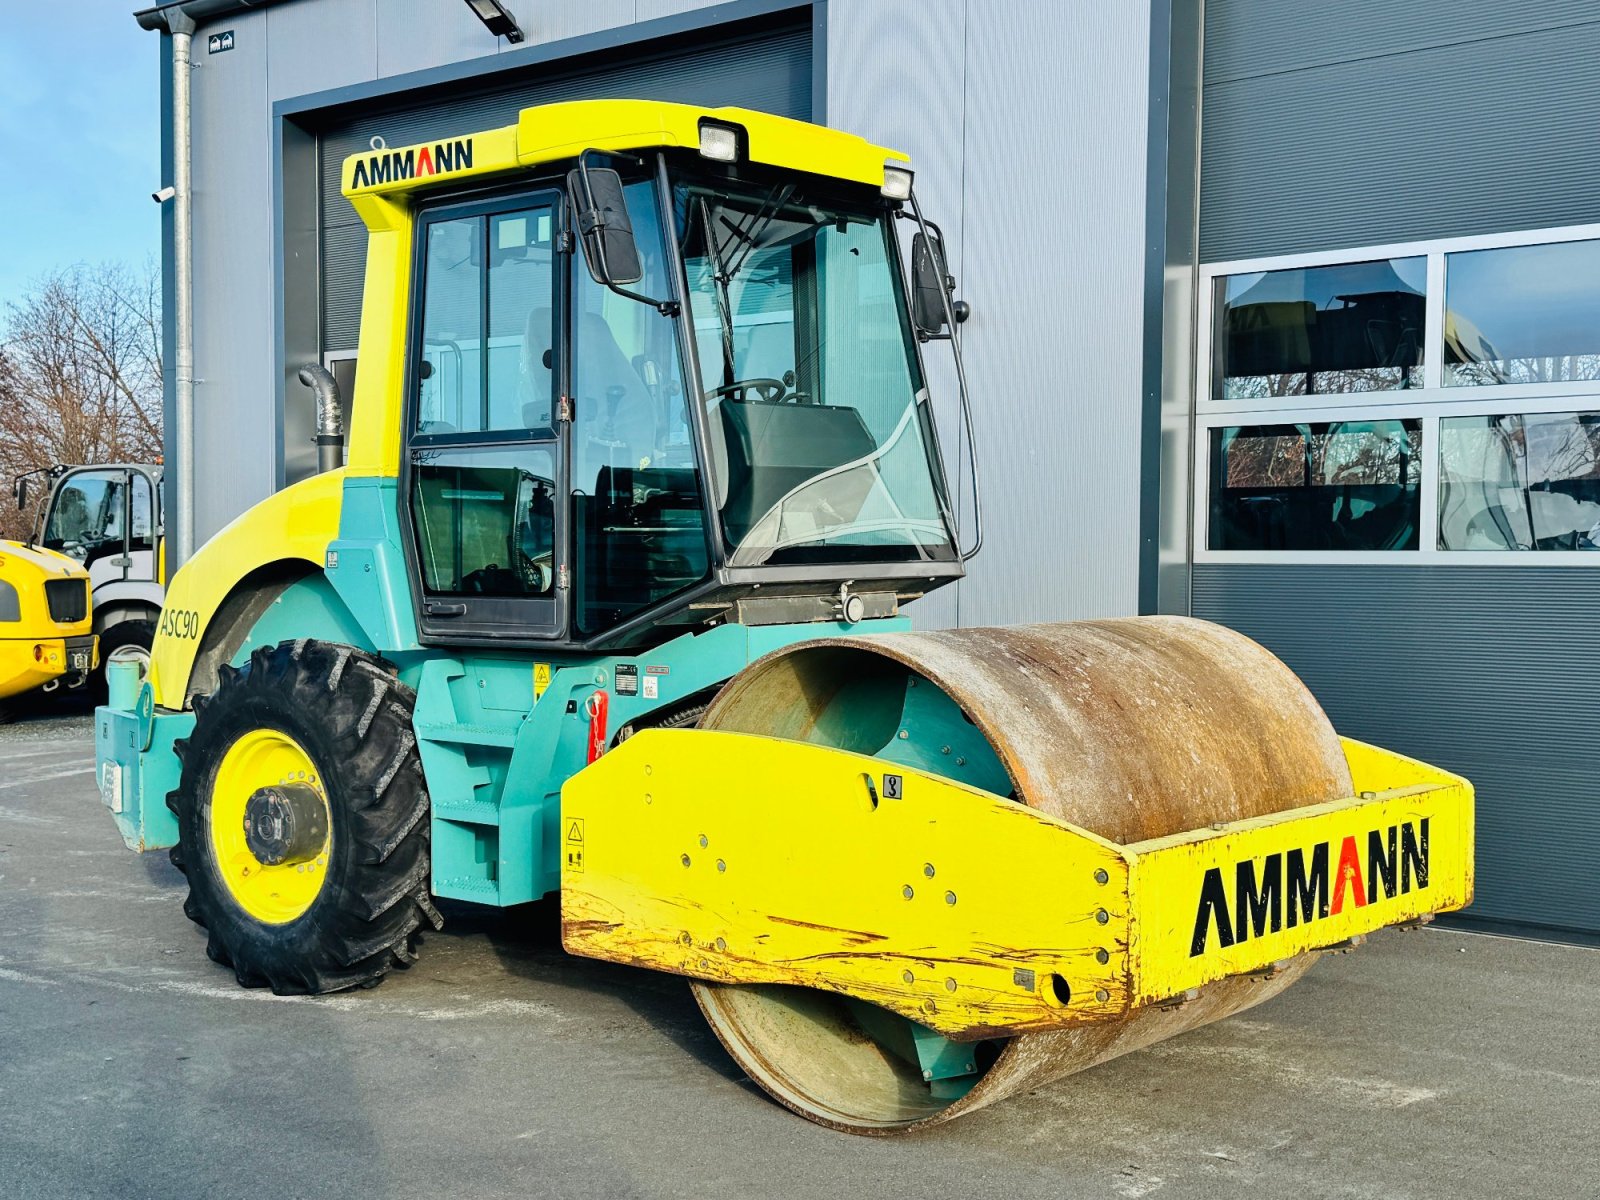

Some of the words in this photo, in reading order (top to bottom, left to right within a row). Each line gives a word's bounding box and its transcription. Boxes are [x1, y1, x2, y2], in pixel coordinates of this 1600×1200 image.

[352, 138, 472, 189] AMMANN
[160, 608, 199, 640] ASC90
[1190, 818, 1429, 958] AMMANN
